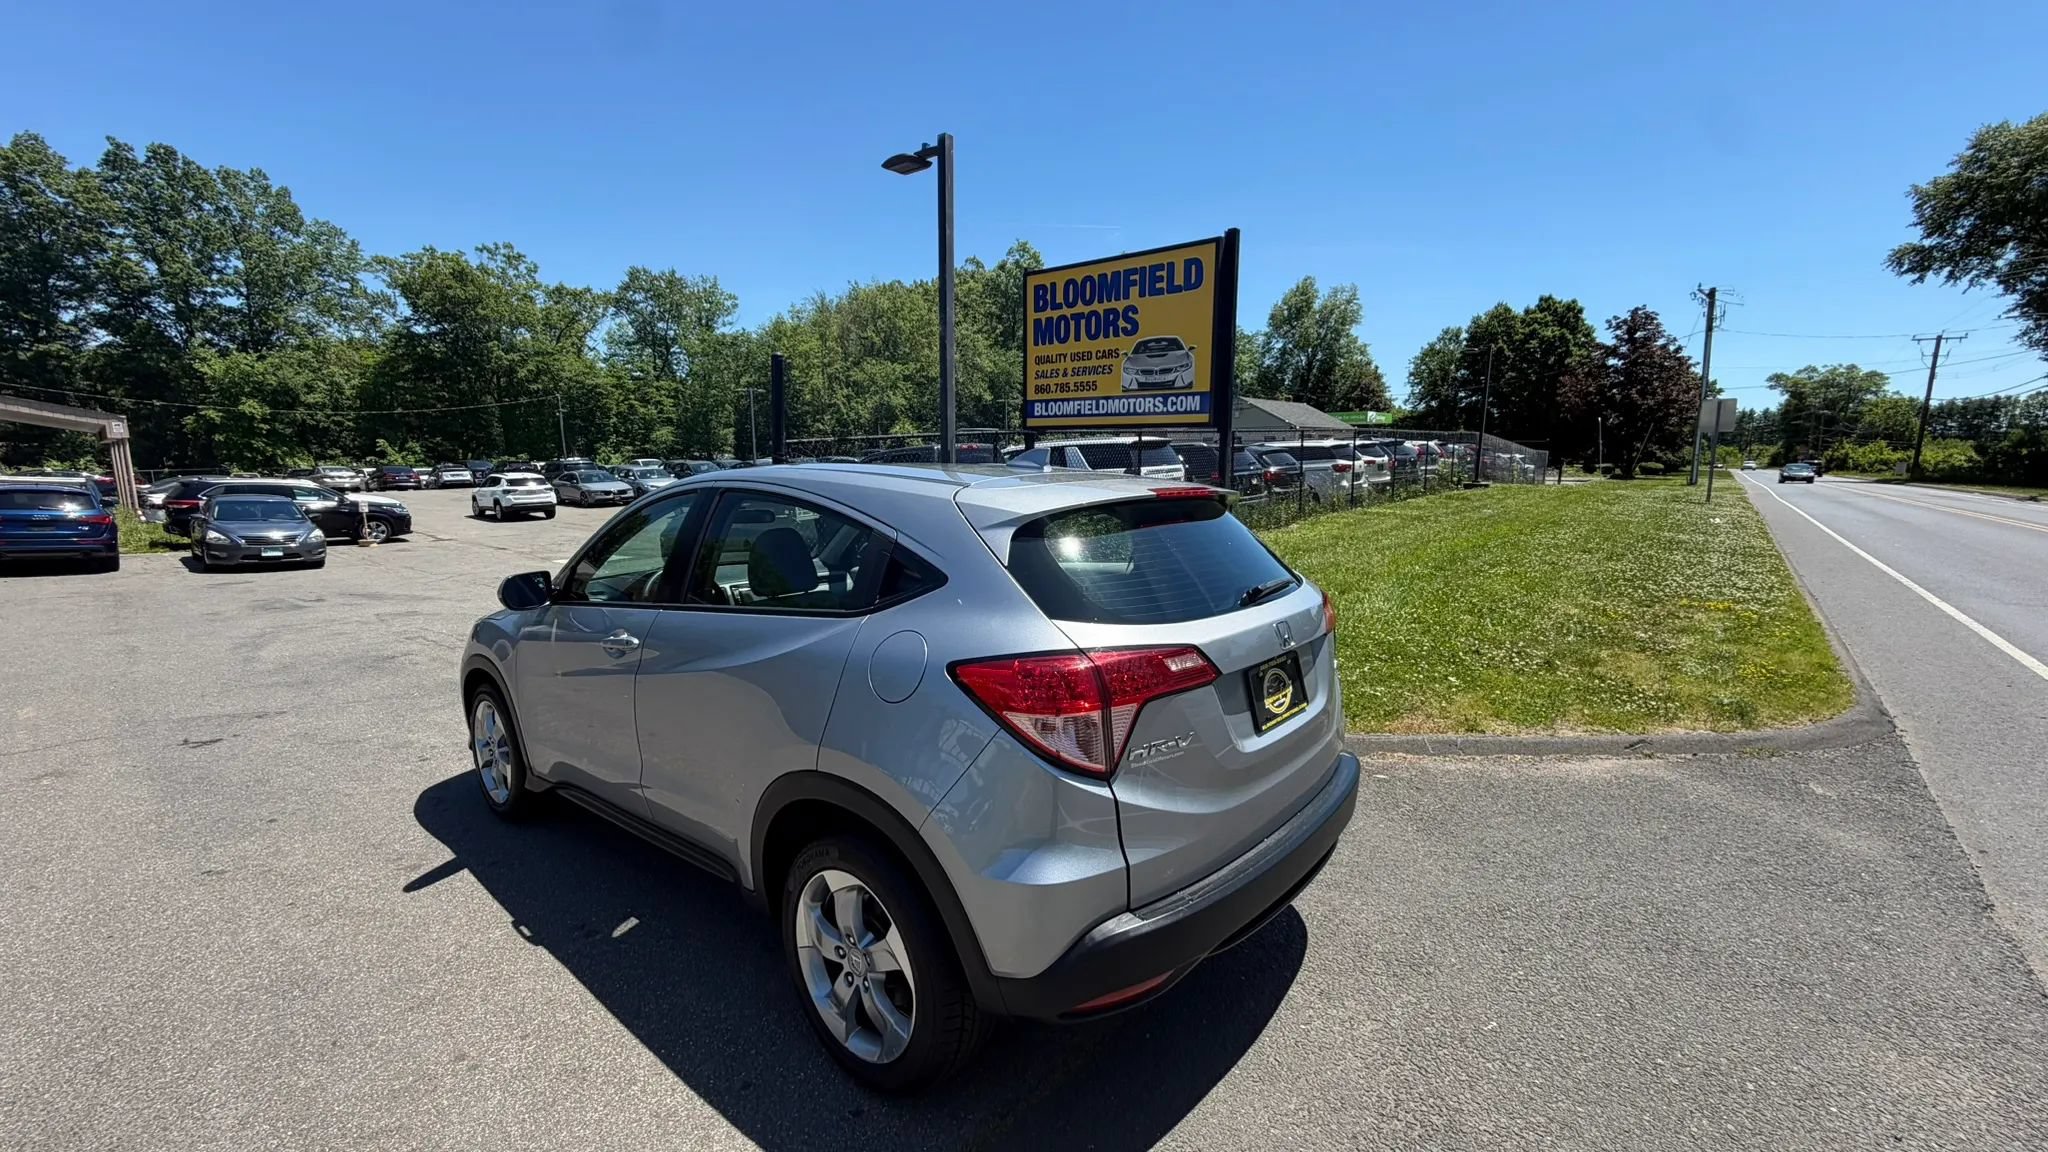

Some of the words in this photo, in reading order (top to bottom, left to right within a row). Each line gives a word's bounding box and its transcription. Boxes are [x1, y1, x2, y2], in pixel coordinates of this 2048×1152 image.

[1033, 257, 1204, 313] BLOOMFIELD
[1033, 304, 1139, 346] MOTORS
[1034, 352, 1068, 366] QUALITY
[1070, 350, 1093, 363] USED
[1095, 348, 1120, 361] CARS
[1034, 367, 1060, 380] SALES
[1062, 367, 1068, 378] &
[1071, 364, 1113, 377] SERVICES
[1034, 380, 1098, 395] 860.785.5555
[1034, 395, 1201, 416] BLOOMFIELDMOTORS.COM
[1127, 731, 1195, 761] HR-V
